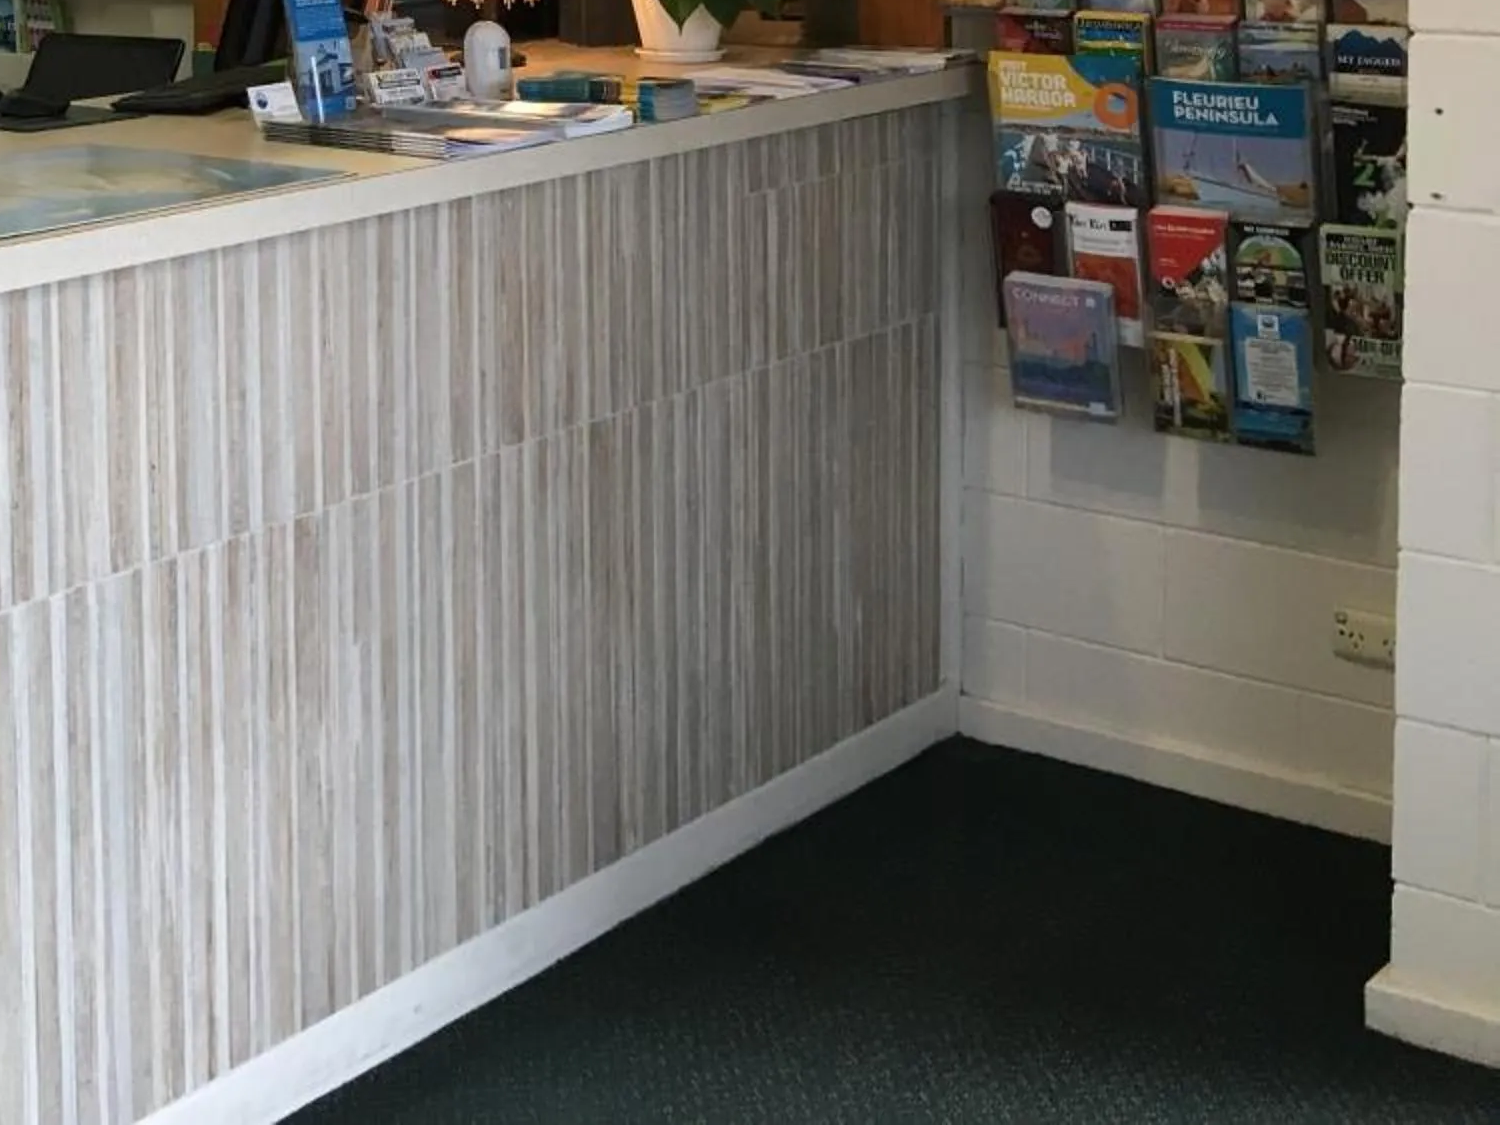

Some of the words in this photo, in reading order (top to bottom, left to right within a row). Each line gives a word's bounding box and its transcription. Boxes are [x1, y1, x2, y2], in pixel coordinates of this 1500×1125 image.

[1000, 70, 1067, 90] VICTOR
[1001, 86, 1077, 108] HARBOR
[1172, 90, 1260, 110] FLEURIEU
[1174, 106, 1280, 126] PENINSULA
[1340, 267, 1385, 284] OFFER
[1012, 286, 1081, 307] CONNECT
